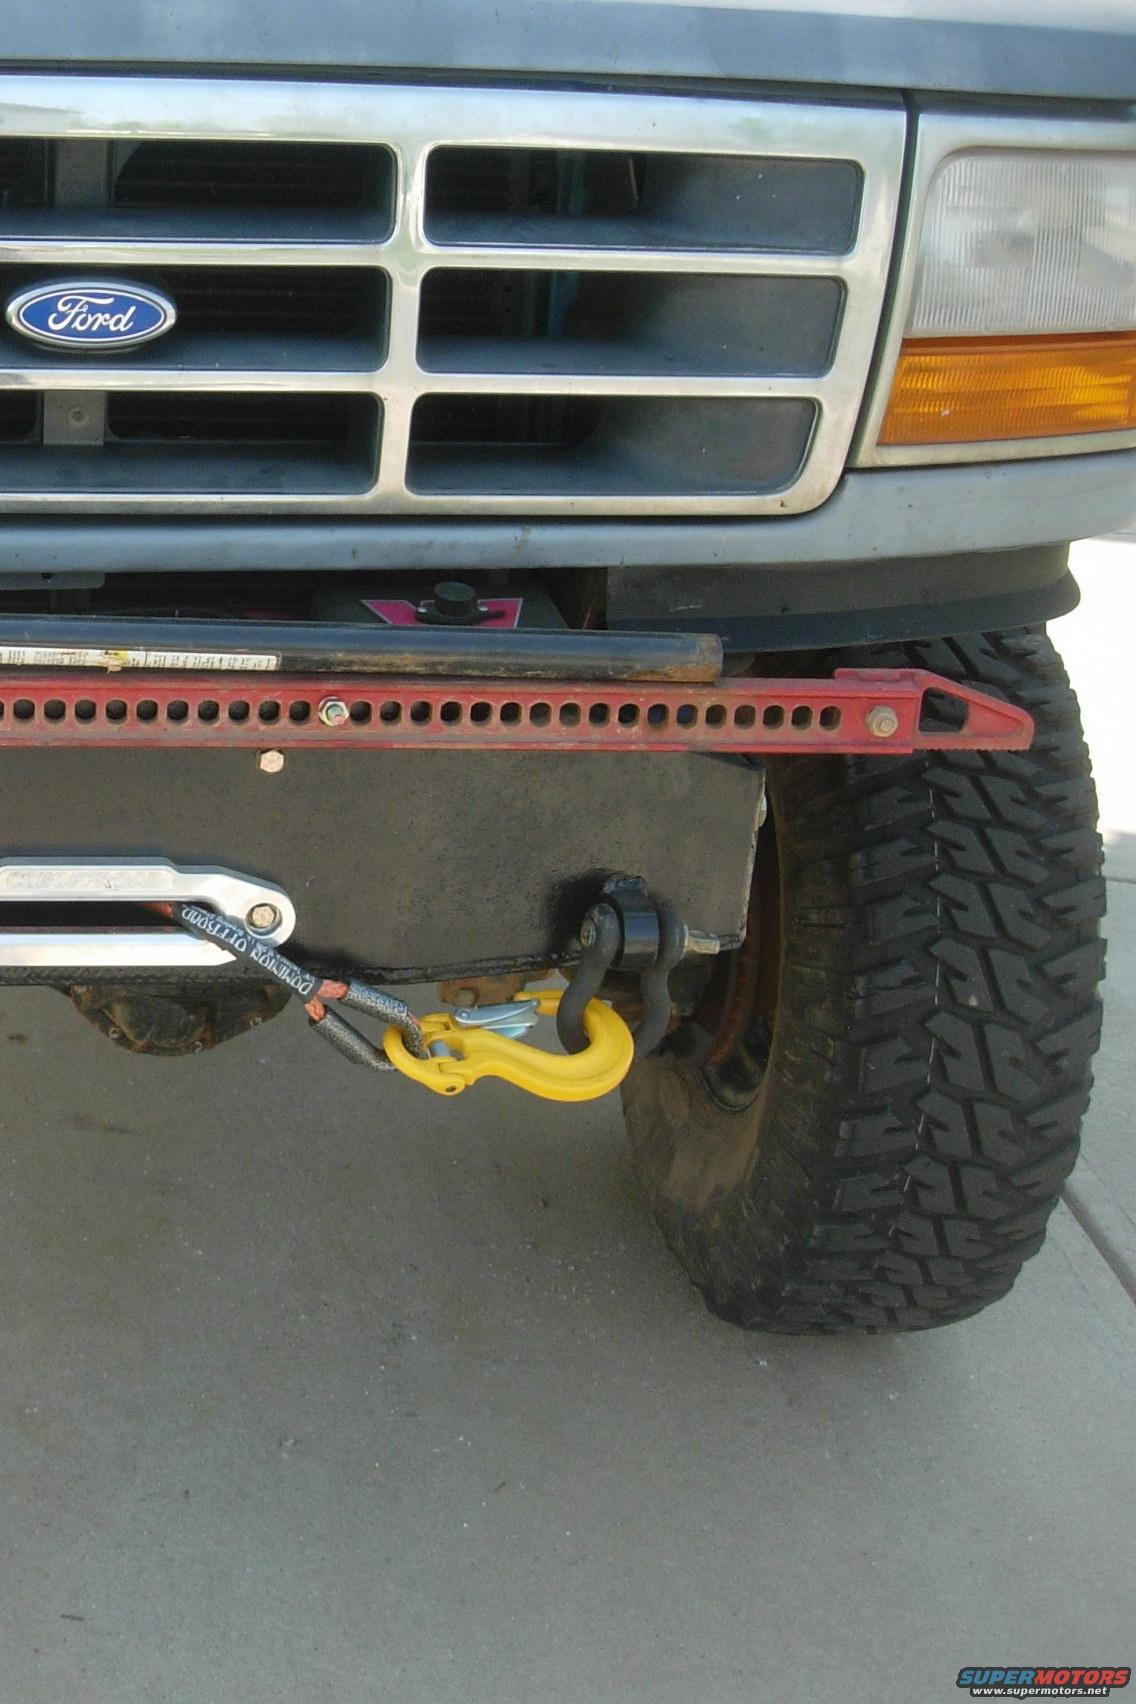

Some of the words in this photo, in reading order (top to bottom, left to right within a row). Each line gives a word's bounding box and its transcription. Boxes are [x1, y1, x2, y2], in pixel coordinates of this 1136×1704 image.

[48, 295, 136, 331] Ford
[181, 907, 245, 952] OFFROAD
[249, 948, 313, 995] DOMINION
